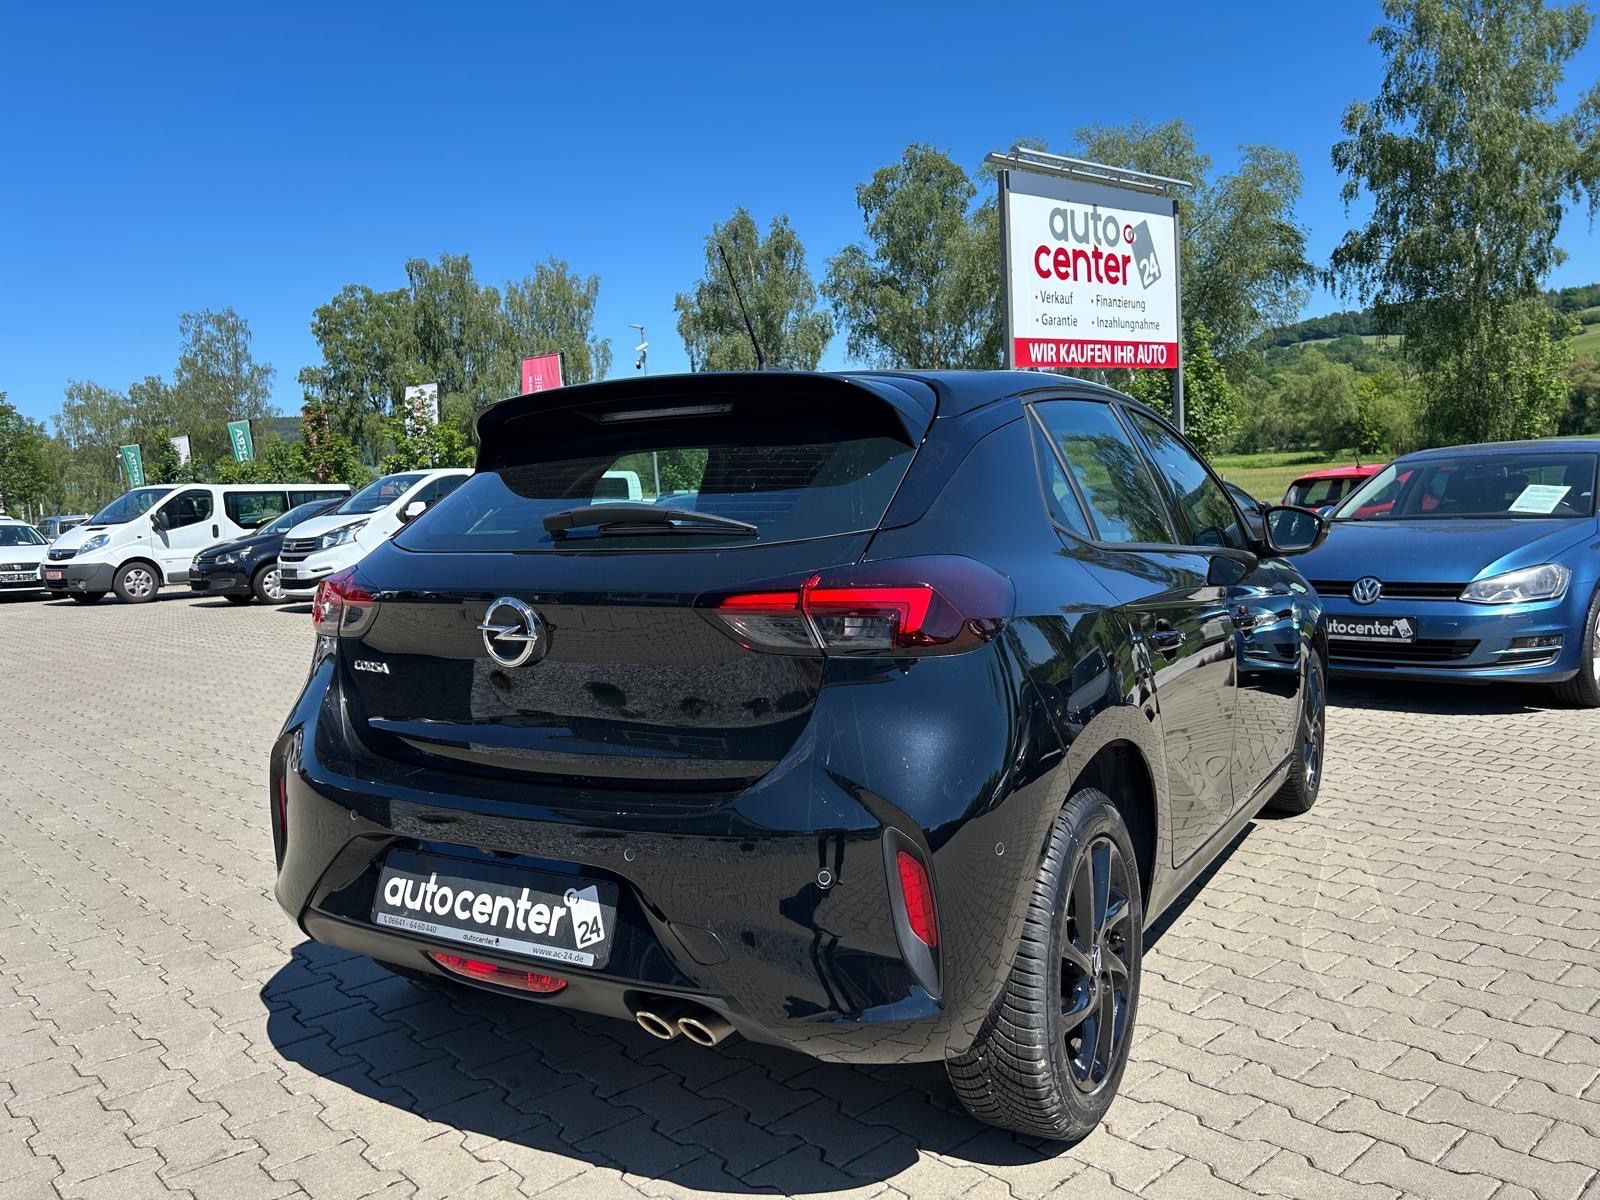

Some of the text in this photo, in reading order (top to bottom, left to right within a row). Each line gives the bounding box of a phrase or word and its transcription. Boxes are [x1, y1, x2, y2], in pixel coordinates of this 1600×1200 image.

[1049, 204, 1120, 247] auto
[1034, 244, 1131, 286] center
[1139, 253, 1160, 283] 24
[1040, 290, 1074, 305] Verkauf
[1096, 295, 1146, 312] Finanzierung
[1041, 313, 1078, 327] Garantie
[1096, 316, 1160, 332] Inzahlungnahme
[1029, 343, 1167, 364] WIR KAUFEN IHR AUTO
[1327, 619, 1396, 636] utocenter
[354, 660, 389, 674] CORSA
[384, 872, 602, 945] autocenter 24
[532, 946, 584, 963] www.ac-24.de
